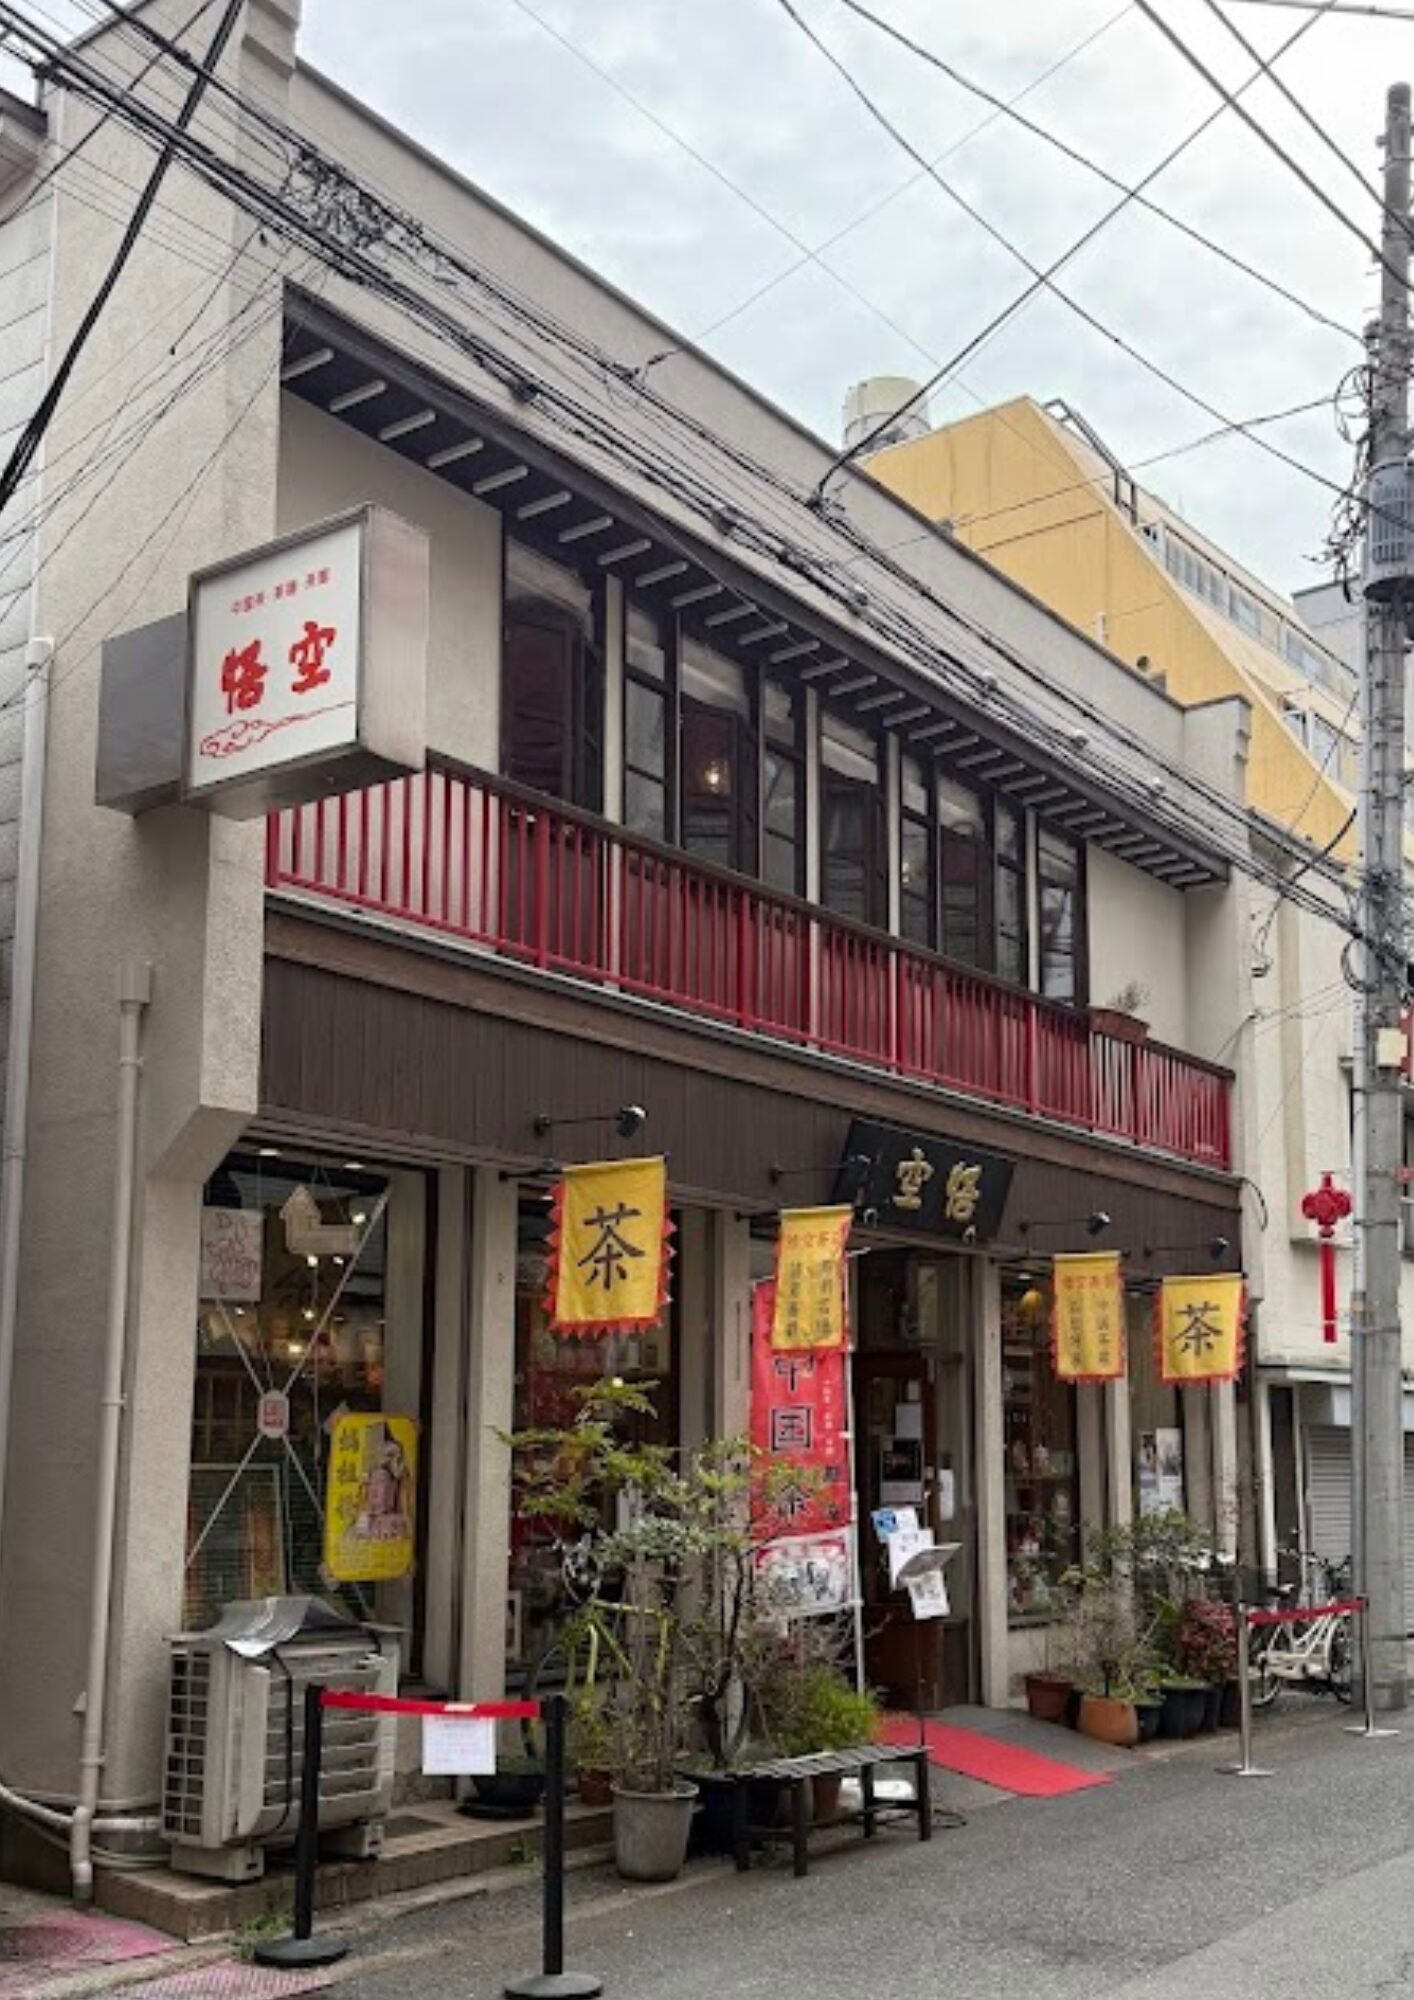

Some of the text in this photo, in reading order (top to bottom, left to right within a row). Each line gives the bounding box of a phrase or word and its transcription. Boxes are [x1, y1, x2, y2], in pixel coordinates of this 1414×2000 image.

[221, 620, 337, 714] 悟空
[577, 1202, 646, 1290] 茶
[1173, 1302, 1222, 1356] 茶
